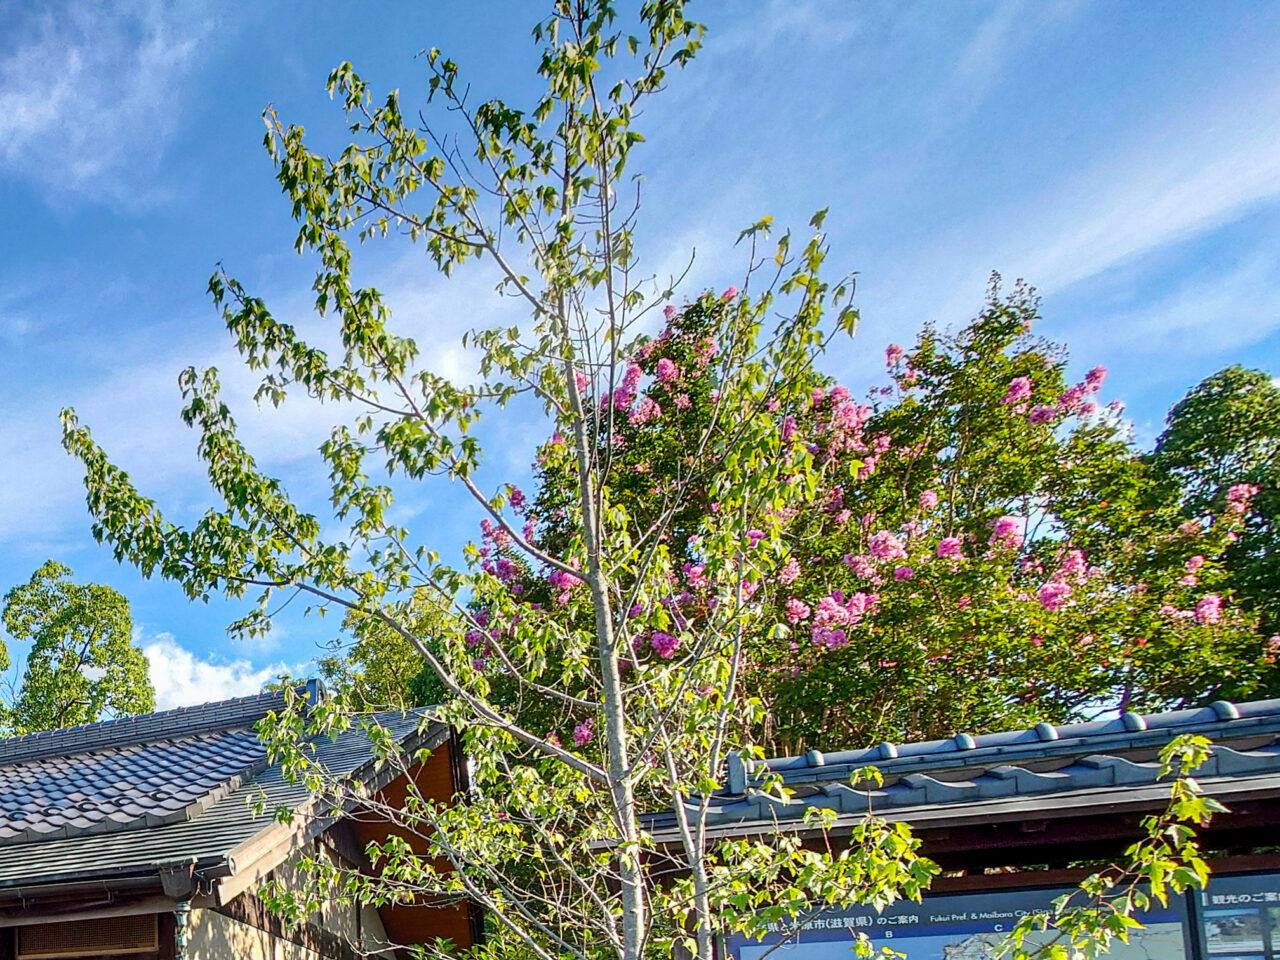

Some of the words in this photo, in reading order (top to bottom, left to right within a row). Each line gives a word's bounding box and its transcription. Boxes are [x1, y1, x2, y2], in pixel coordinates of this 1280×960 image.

[1212, 892, 1280, 904] 観光のご案
[994, 924, 1003, 932] C
[885, 930, 893, 938] B
